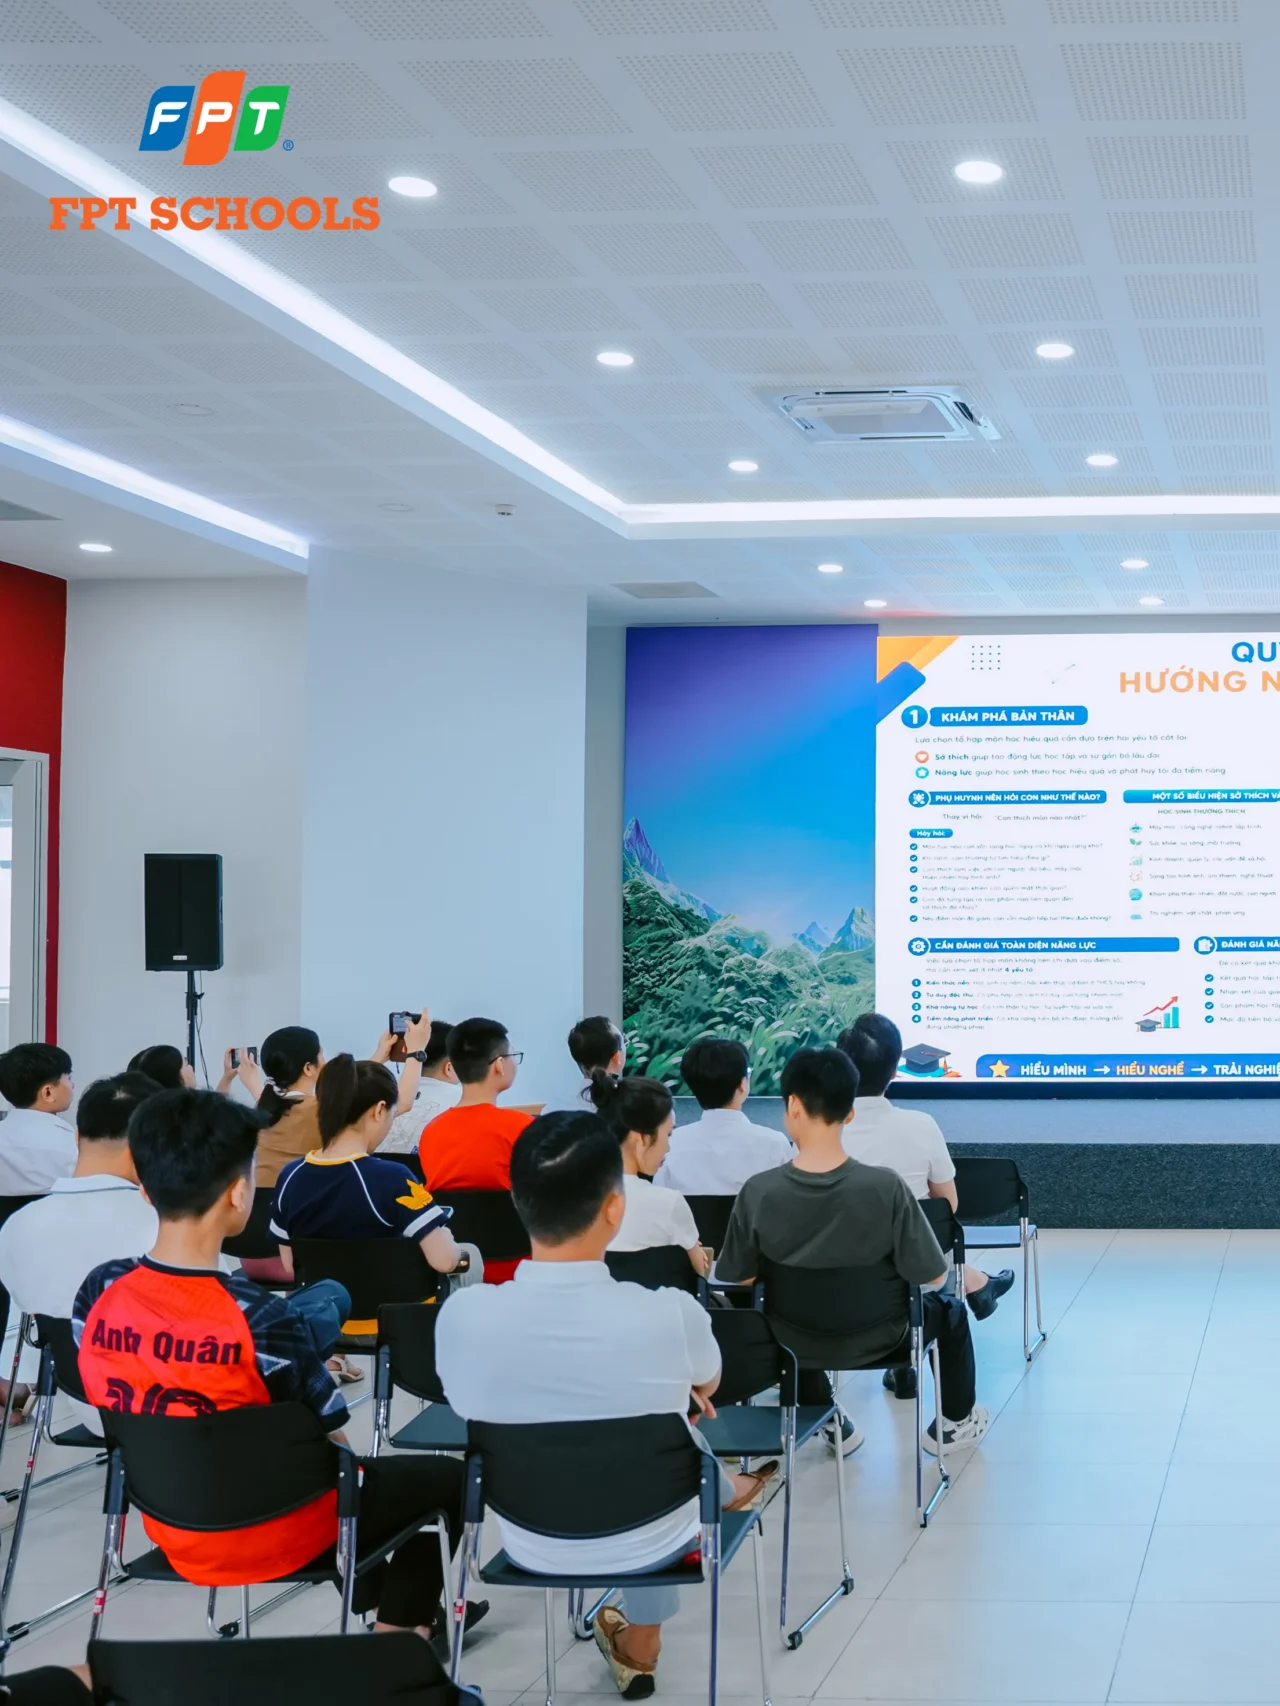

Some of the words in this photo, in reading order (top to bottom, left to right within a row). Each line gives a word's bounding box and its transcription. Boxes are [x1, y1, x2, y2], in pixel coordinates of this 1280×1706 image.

[1119, 666, 1246, 693] HƯỚNG
[909, 709, 919, 725] 1
[942, 710, 978, 722] KHÁM
[982, 710, 1007, 722] PHÁ
[1011, 709, 1036, 722] BẢN
[1040, 709, 1075, 721] THÂN
[936, 794, 952, 803] PHỤ
[985, 792, 1002, 801] NÊN
[1078, 792, 1100, 801] NÀO?
[1152, 792, 1171, 801] MỘT
[1173, 792, 1185, 800] SỐ
[1208, 792, 1228, 801] HIỆN
[1230, 791, 1242, 799] SỞ
[935, 940, 954, 949] CẦN
[956, 940, 981, 949] ĐÁNH
[983, 940, 999, 949] GIÁ
[1001, 940, 1026, 949] TOÀN
[1028, 941, 1048, 951] DIỆN
[1051, 940, 1077, 949] NĂNG
[1079, 942, 1096, 951] LỰC
[1221, 939, 1246, 948] ĐÁNH
[1249, 939, 1264, 948] GIÁ
[1053, 1062, 1087, 1075] MÌNH
[1116, 1061, 1146, 1075] HIỂU
[1149, 1061, 1184, 1075] NGHỀ
[1213, 1062, 1241, 1075] TRẢI
[92, 1318, 142, 1355] Anh
[153, 1331, 242, 1365] Quân
